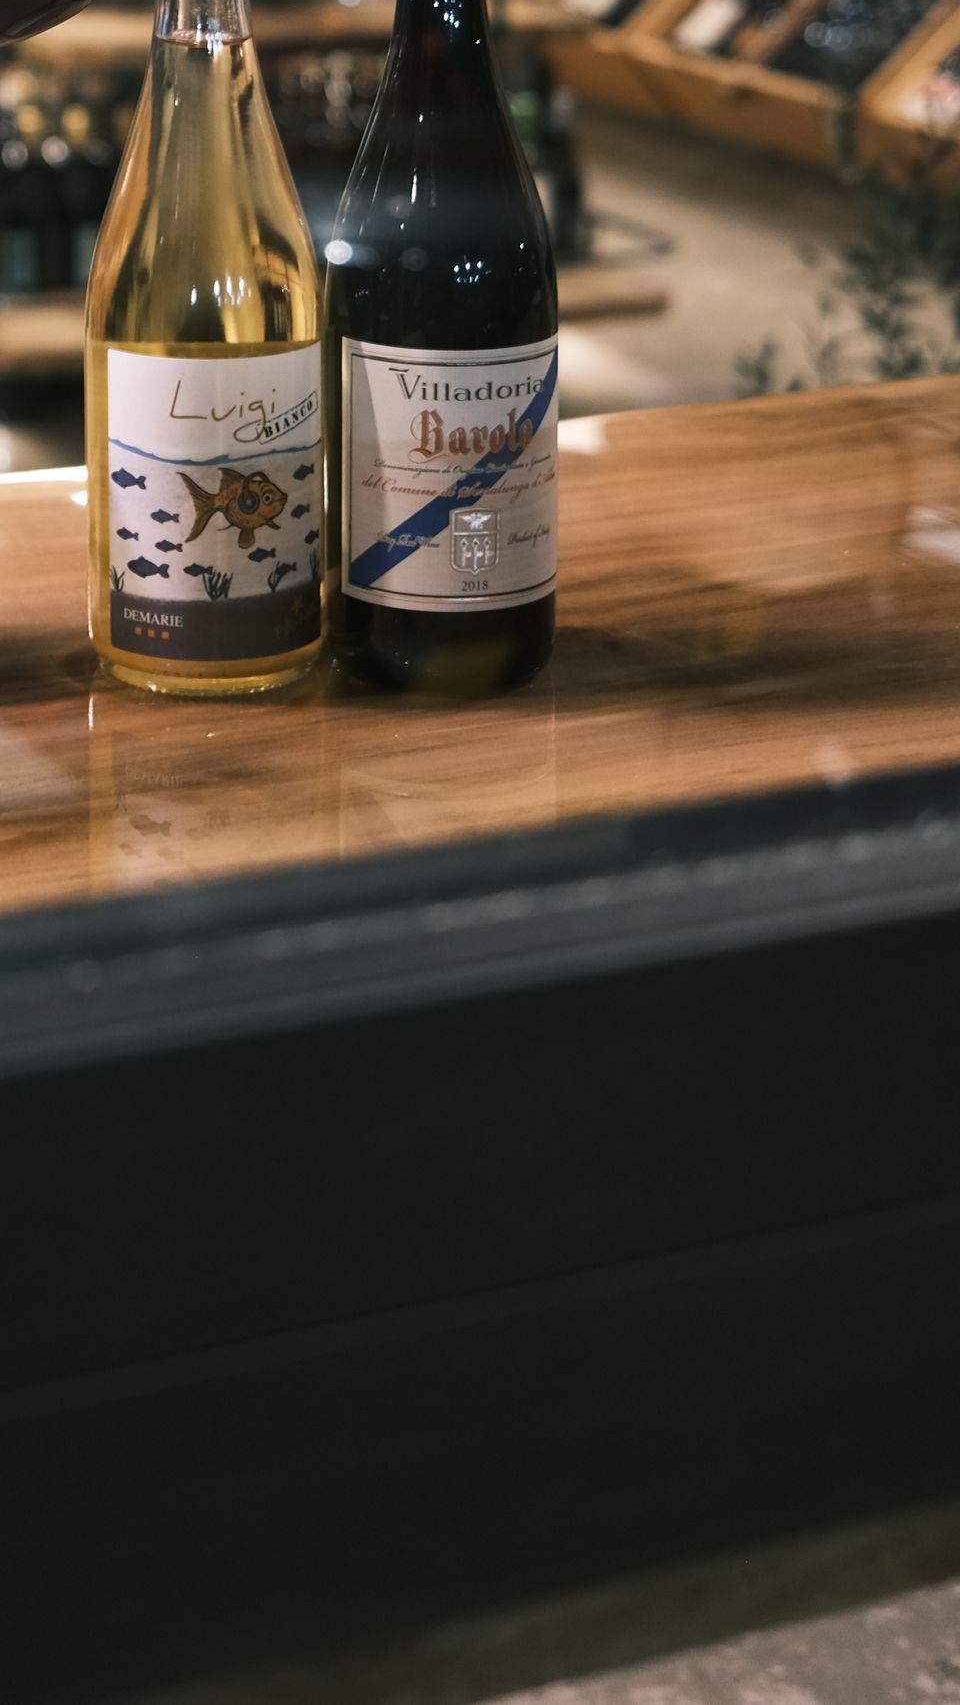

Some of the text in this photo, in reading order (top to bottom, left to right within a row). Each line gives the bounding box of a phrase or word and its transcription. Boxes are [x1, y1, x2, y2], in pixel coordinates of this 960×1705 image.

[388, 367, 545, 402] Villadoria
[169, 379, 277, 443] Luigi
[263, 399, 313, 438] BIANCO
[408, 407, 534, 463] Barolo
[461, 580, 489, 592] 2018
[123, 607, 183, 628] DEMARIE
